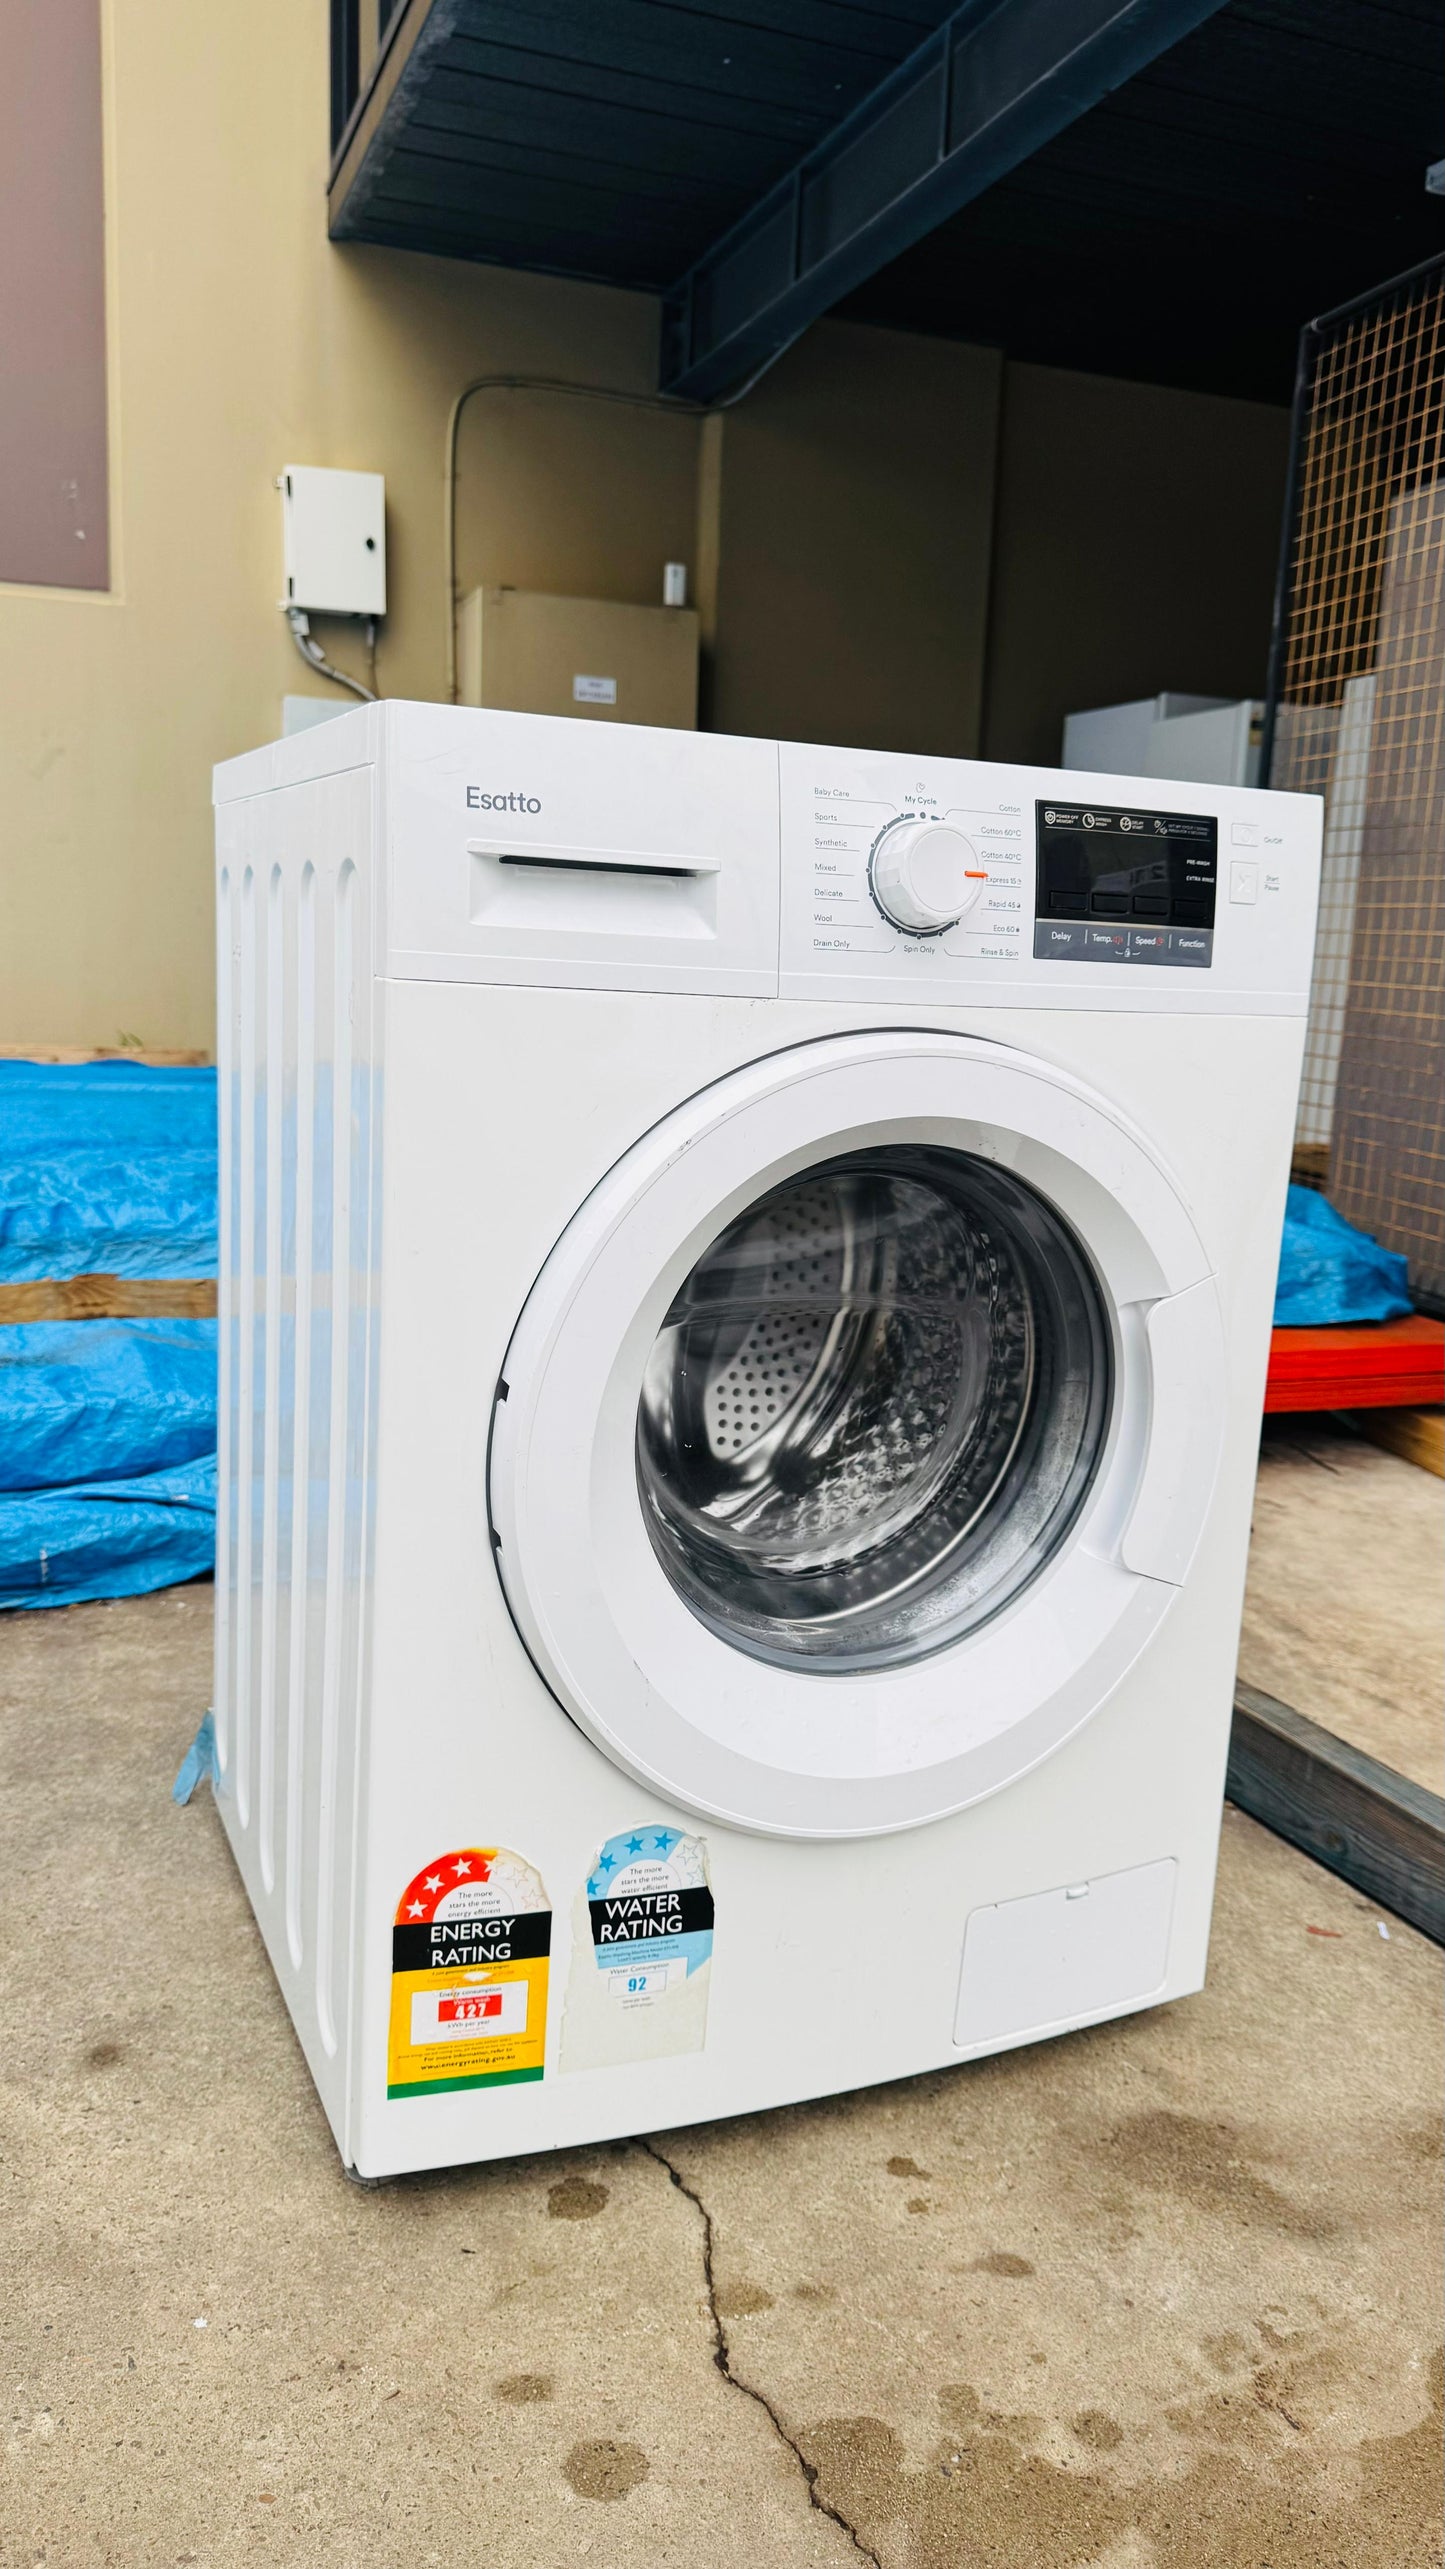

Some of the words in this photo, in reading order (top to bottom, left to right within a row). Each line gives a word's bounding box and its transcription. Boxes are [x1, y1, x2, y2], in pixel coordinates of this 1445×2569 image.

[814, 787, 832, 797] Baby
[833, 789, 850, 798] Care
[466, 785, 542, 814] Esatto
[904, 796, 918, 805] My
[918, 797, 937, 806] Cycle
[999, 804, 1022, 813] Cotton
[814, 813, 838, 822] Sports
[981, 826, 1002, 836] Cotton
[814, 838, 848, 848] Synthetic
[981, 850, 1004, 860] Cotton
[814, 863, 837, 872] Mixed
[986, 877, 1009, 885] Express
[814, 889, 843, 898] Delicate
[988, 899, 1007, 908] Rapid
[813, 914, 833, 922] Wool
[993, 924, 1005, 932] Eco
[1006, 925, 1015, 933] 60
[1051, 931, 1072, 942] Delay
[1092, 933, 1112, 944] Temp.
[1135, 936, 1156, 946] Speed
[813, 939, 832, 948] Drain
[833, 940, 850, 949] Only
[1178, 938, 1205, 948] Function
[903, 944, 919, 954] Spin
[920, 945, 936, 955] Only
[981, 947, 998, 956] Rinse
[1005, 948, 1019, 957] Spin
[630, 1868, 643, 1876] The
[621, 1878, 637, 1886] stars
[642, 1884, 668, 1892] efficient
[458, 1891, 472, 1899] The
[481, 1898, 501, 1906] more
[605, 1894, 681, 1920] WATER
[448, 1910, 472, 1919] energy
[473, 1908, 501, 1916] efficient
[430, 1918, 516, 1943] ENERGY
[600, 1915, 683, 1943] RATING
[432, 1943, 511, 1967] RATING
[630, 1963, 670, 1972] Consumption
[628, 1976, 647, 1992] 92
[440, 1990, 460, 1998] Energy
[462, 1986, 502, 1995] consumption
[455, 2002, 486, 2019] 427
